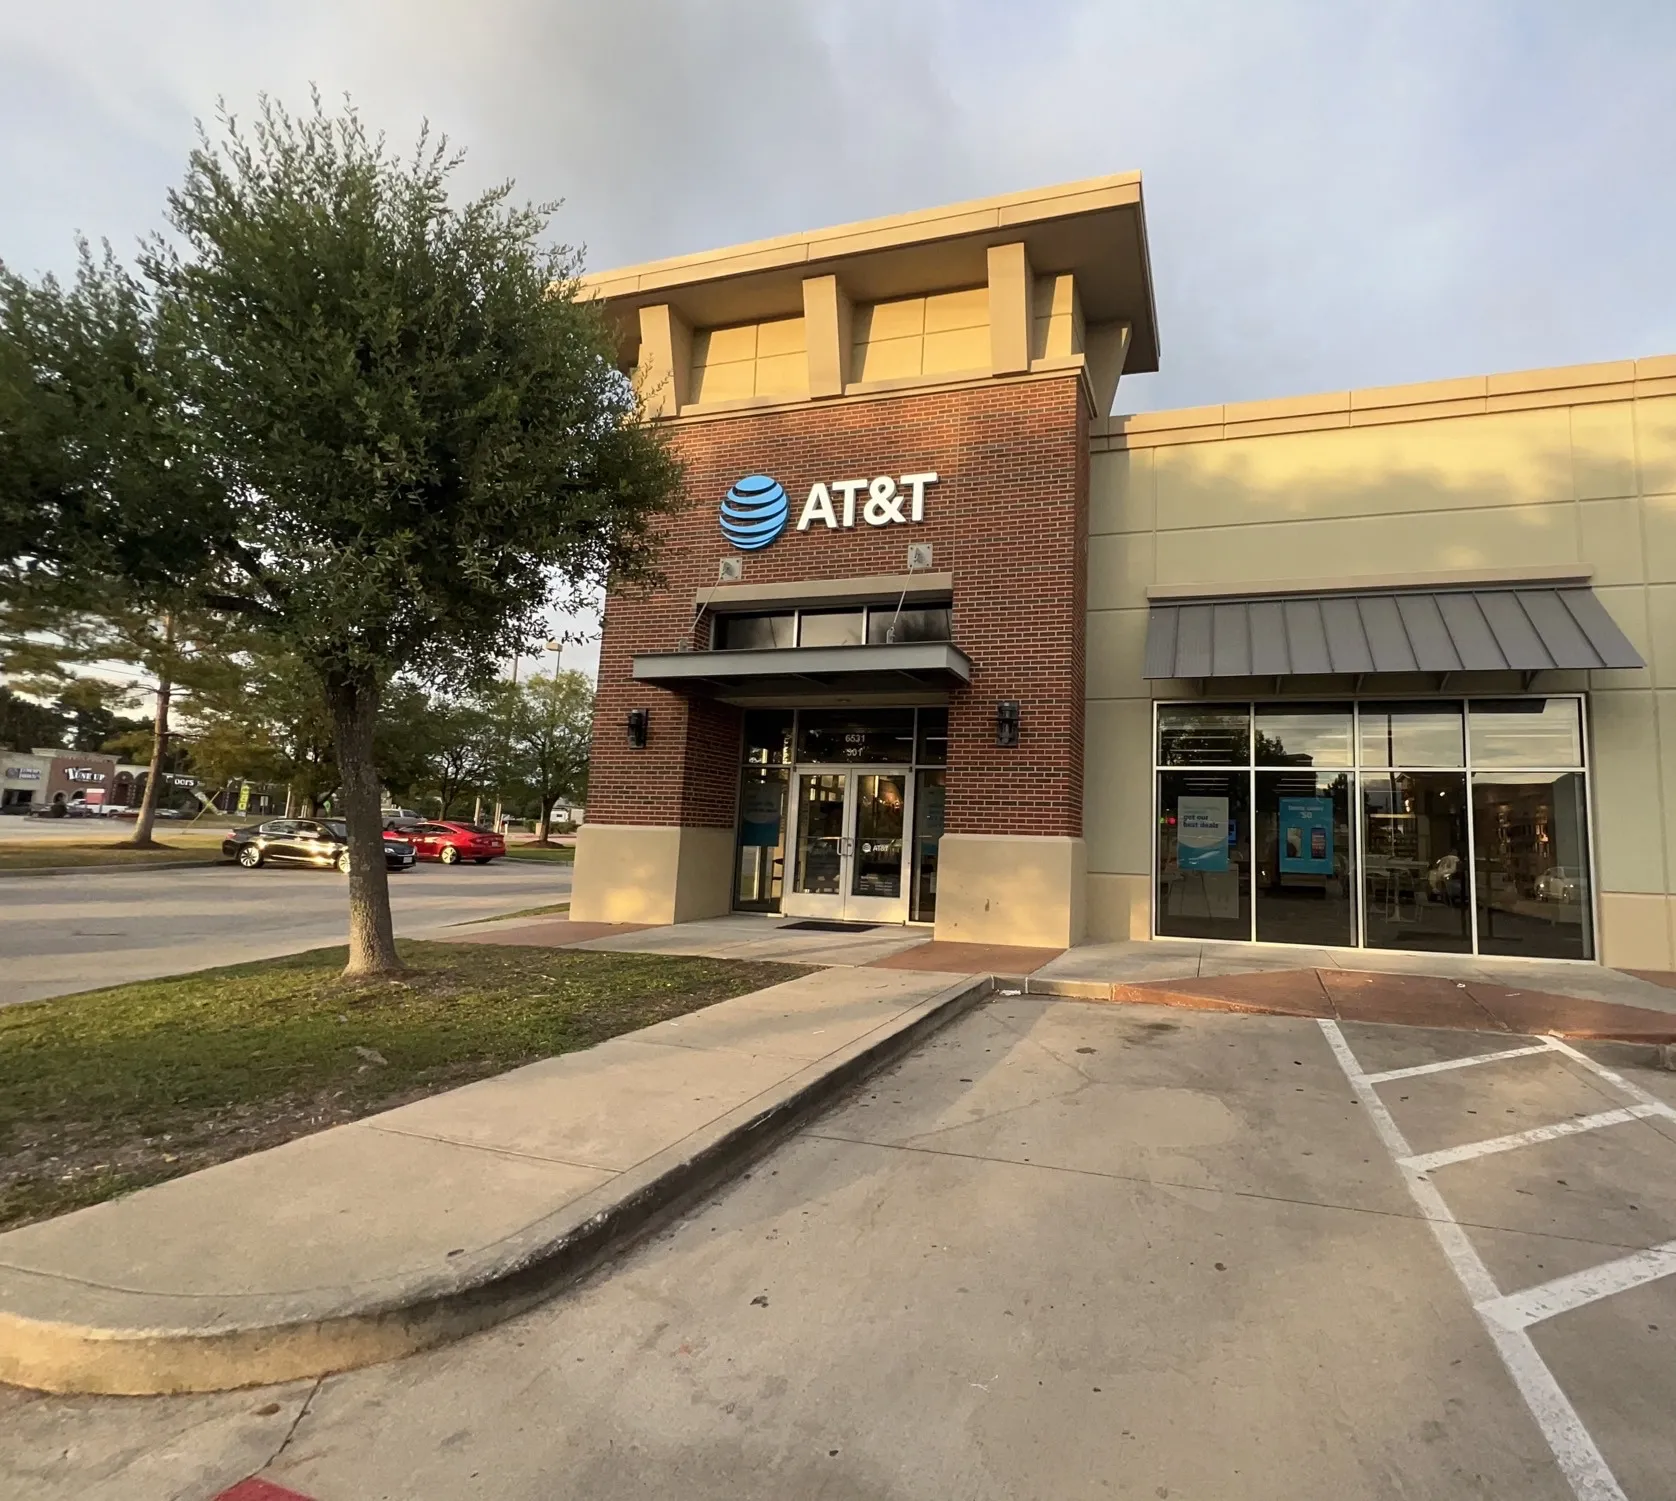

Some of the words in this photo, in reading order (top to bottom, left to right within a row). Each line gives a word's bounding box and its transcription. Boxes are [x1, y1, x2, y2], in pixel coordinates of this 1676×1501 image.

[796, 472, 940, 532] AT&T
[845, 734, 865, 743] 6531
[93, 773, 105, 781] UP
[1183, 814, 1196, 822] get
[872, 844, 888, 852] AT&T
